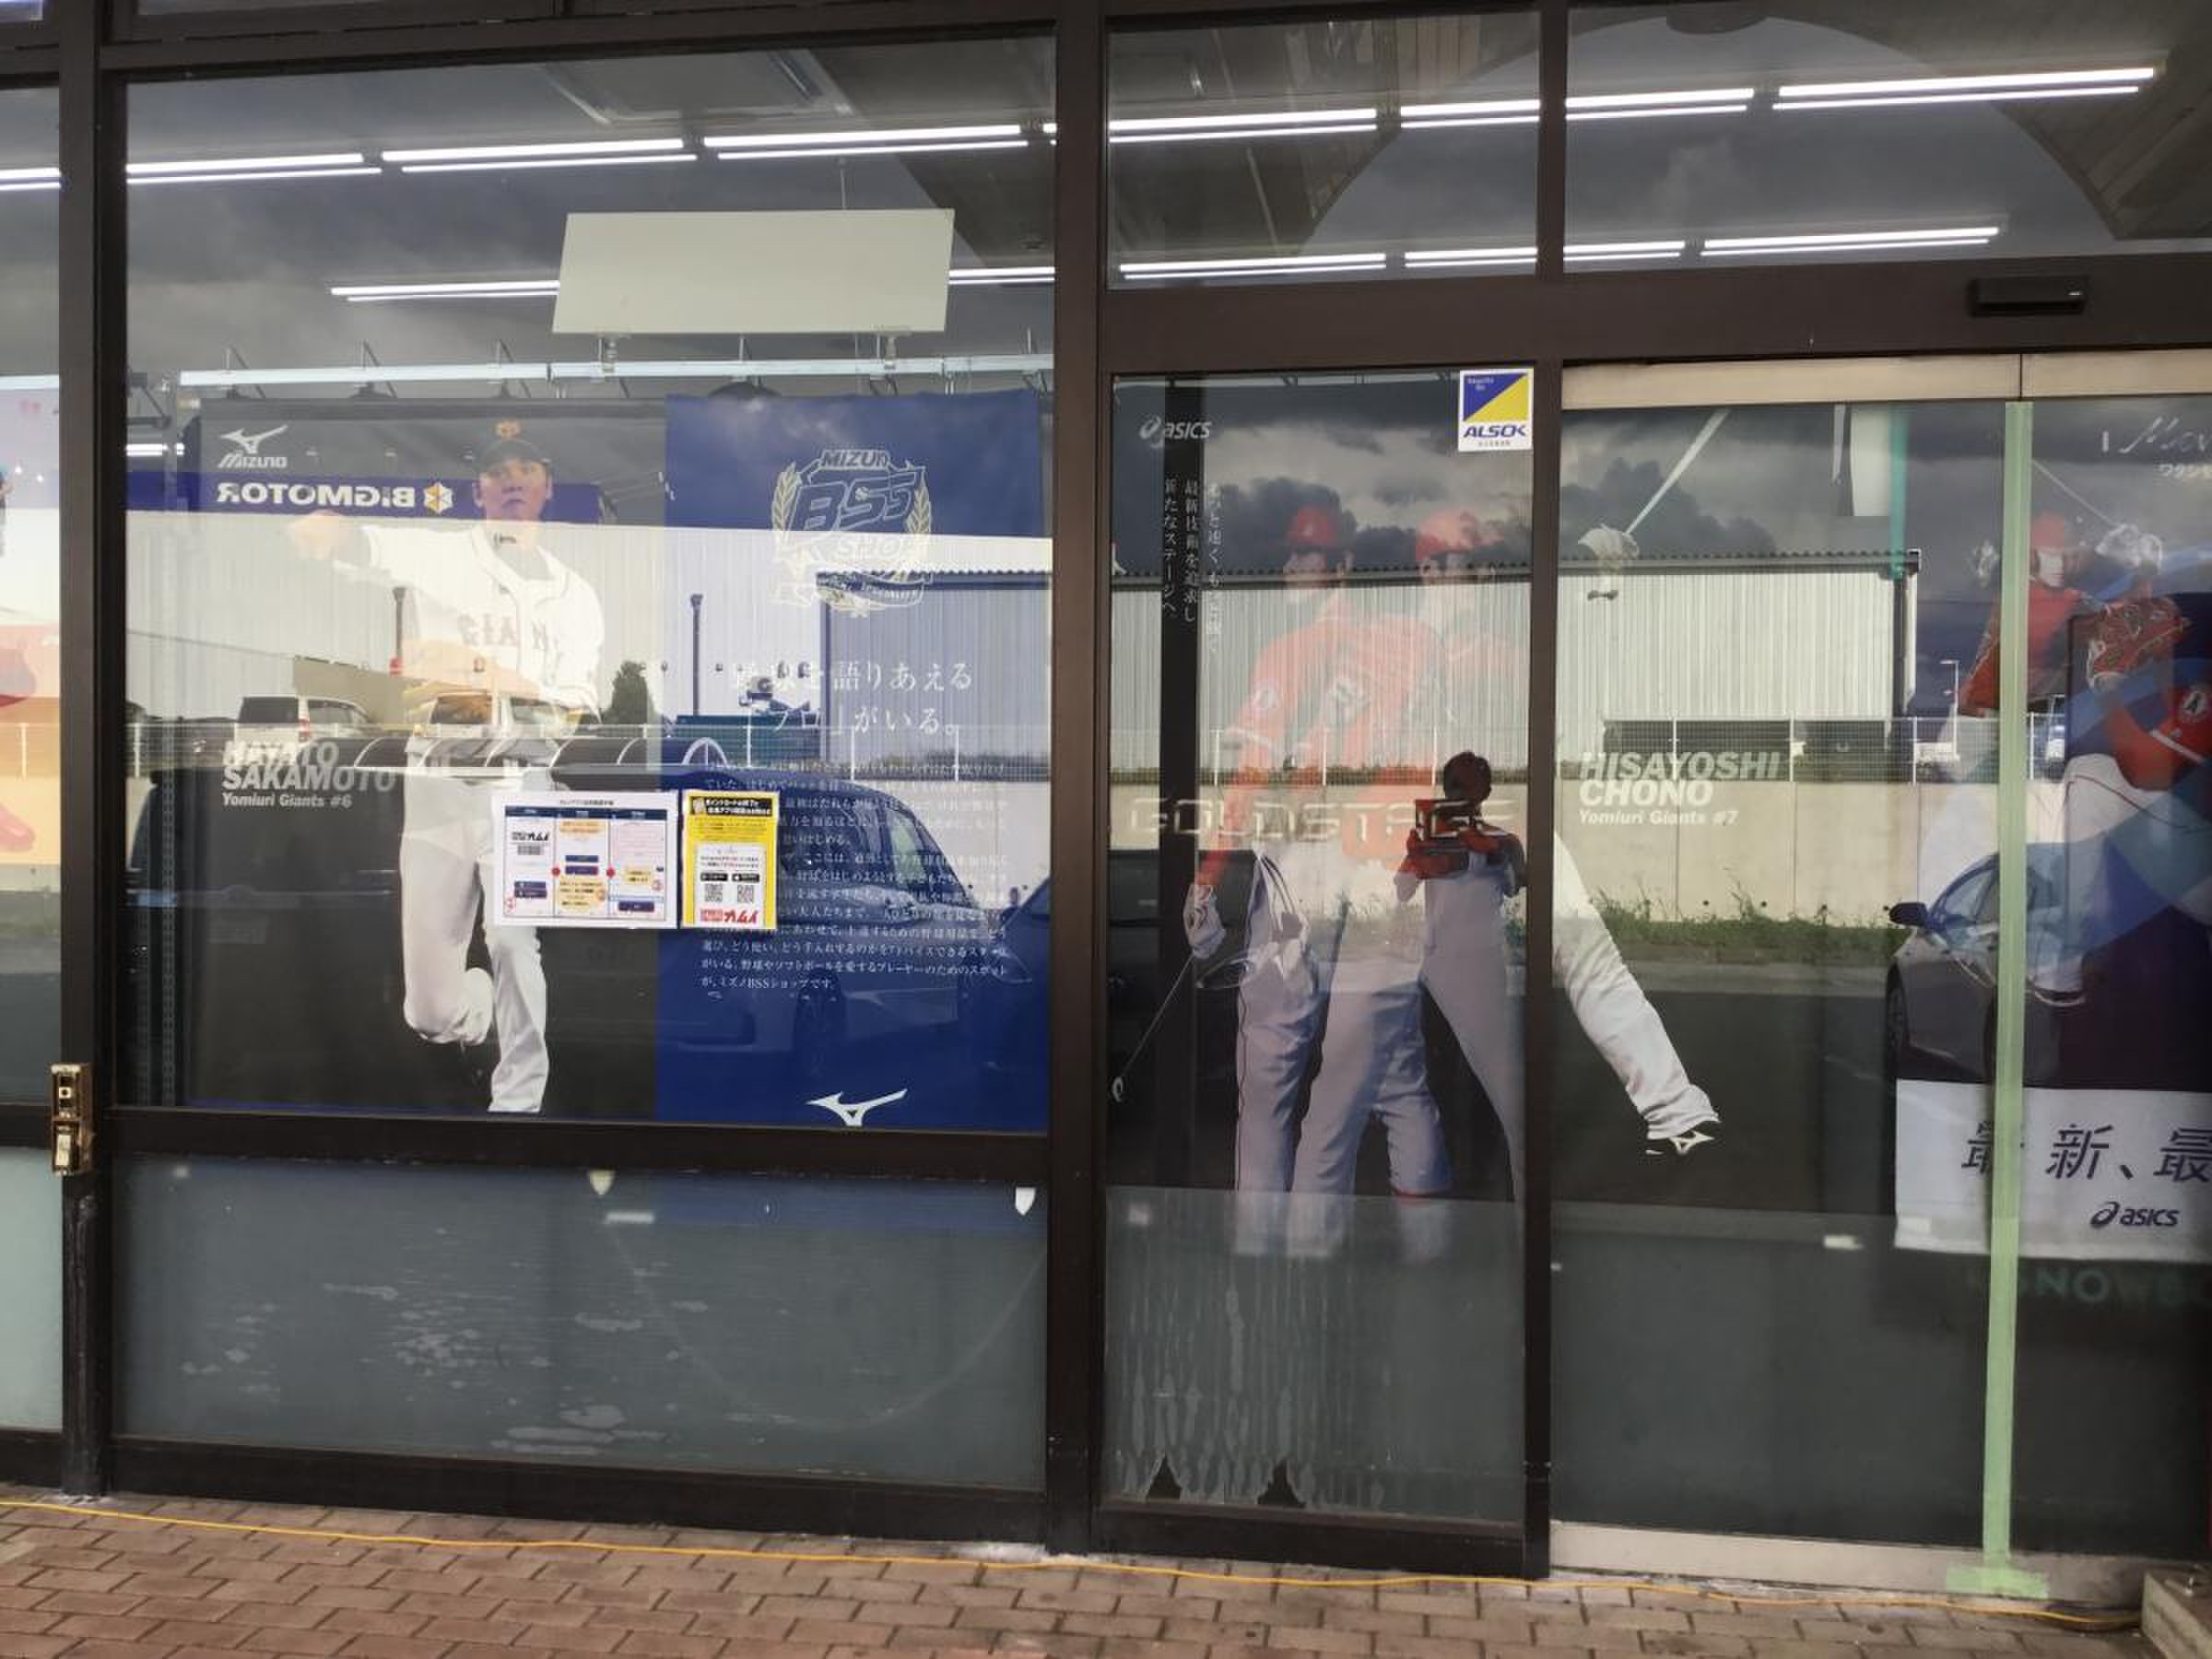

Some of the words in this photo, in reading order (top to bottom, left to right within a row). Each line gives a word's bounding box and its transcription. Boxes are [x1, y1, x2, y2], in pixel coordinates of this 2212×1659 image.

[1163, 421, 1212, 440] asics
[1464, 425, 1526, 438] ALSOK
[1579, 751, 1781, 780] HISAYOSHI
[221, 764, 396, 792] SAKAMOTO
[222, 792, 276, 807] Yomiuri
[279, 793, 325, 807] Giants
[1578, 779, 1714, 806] CHONO
[1579, 808, 1644, 825] Yomiuri
[1649, 809, 1707, 825] Giants
[2120, 1207, 2182, 1228] asics
